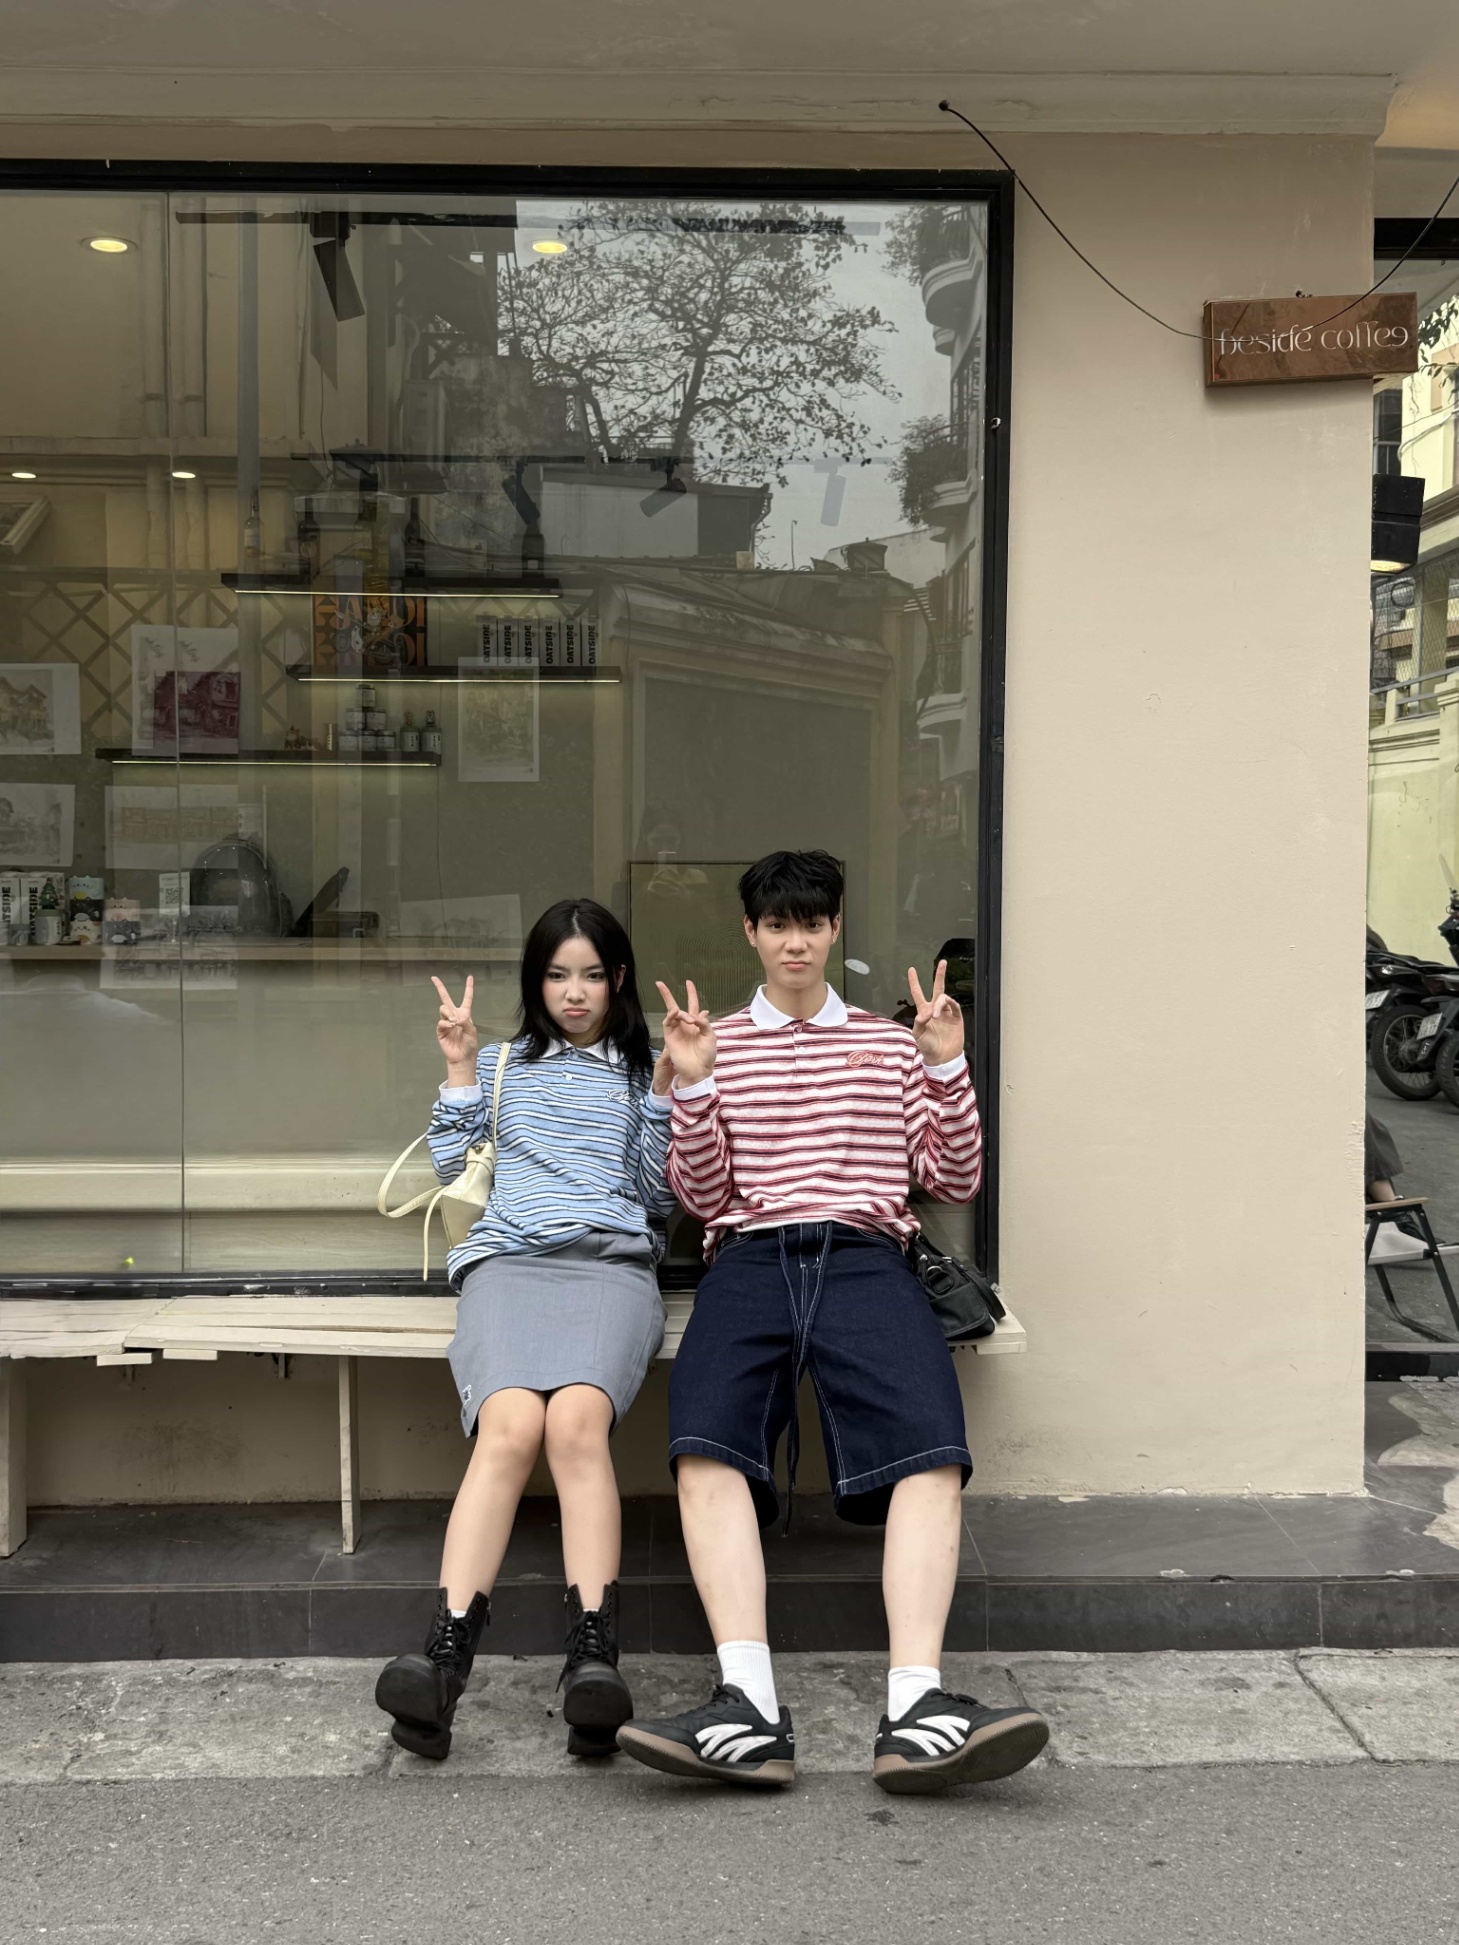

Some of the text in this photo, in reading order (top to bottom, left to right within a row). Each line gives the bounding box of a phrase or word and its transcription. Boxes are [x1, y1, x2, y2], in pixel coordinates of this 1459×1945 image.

[482, 624, 491, 663] OATSIDE
[504, 625, 512, 664] OATSIDE
[524, 625, 532, 664] OATSIDE
[545, 625, 553, 664] OATSIDE
[566, 624, 574, 664] OATSIDE
[588, 625, 596, 665] OATSIDE
